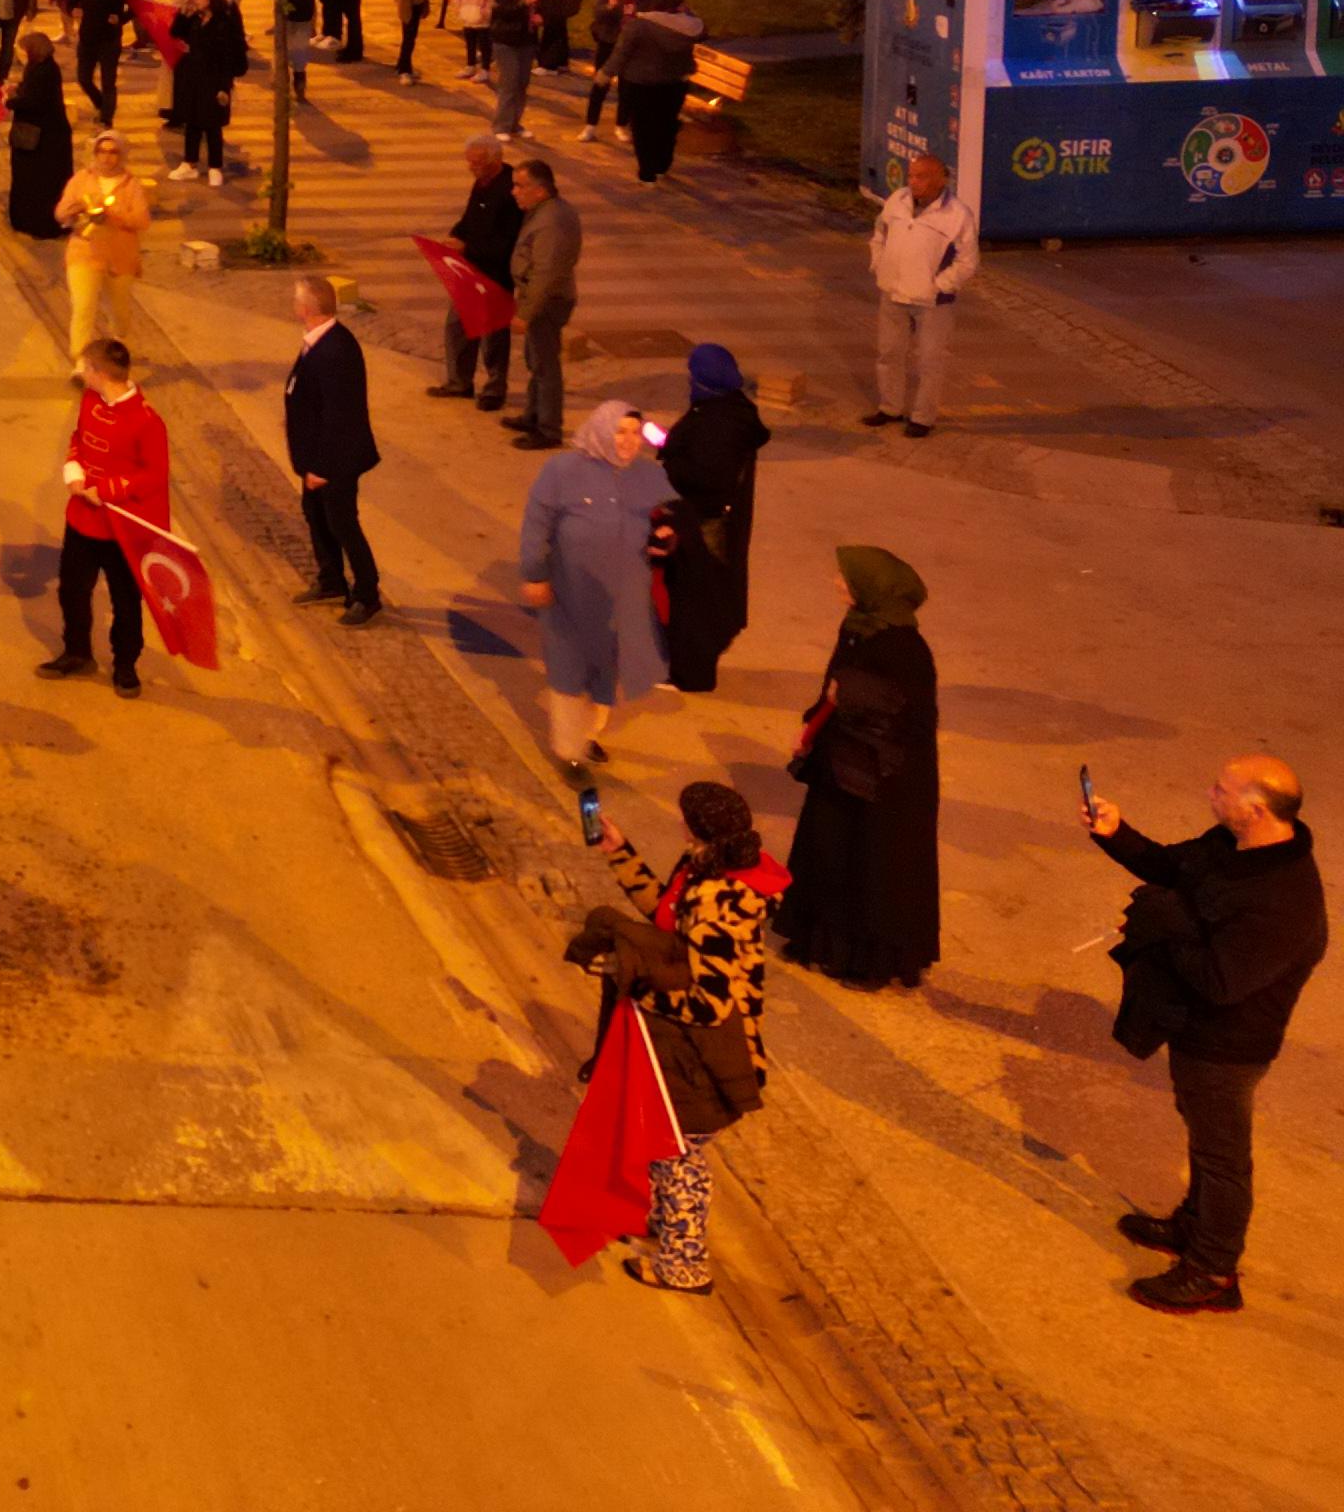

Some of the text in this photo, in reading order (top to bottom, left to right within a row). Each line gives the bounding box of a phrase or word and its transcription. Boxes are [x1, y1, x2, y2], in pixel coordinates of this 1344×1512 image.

[1020, 68, 1053, 81] KAĞIT
[1064, 68, 1111, 79] KARTON
[1059, 139, 1112, 157] SIFIR
[1059, 157, 1109, 175] ATIK
